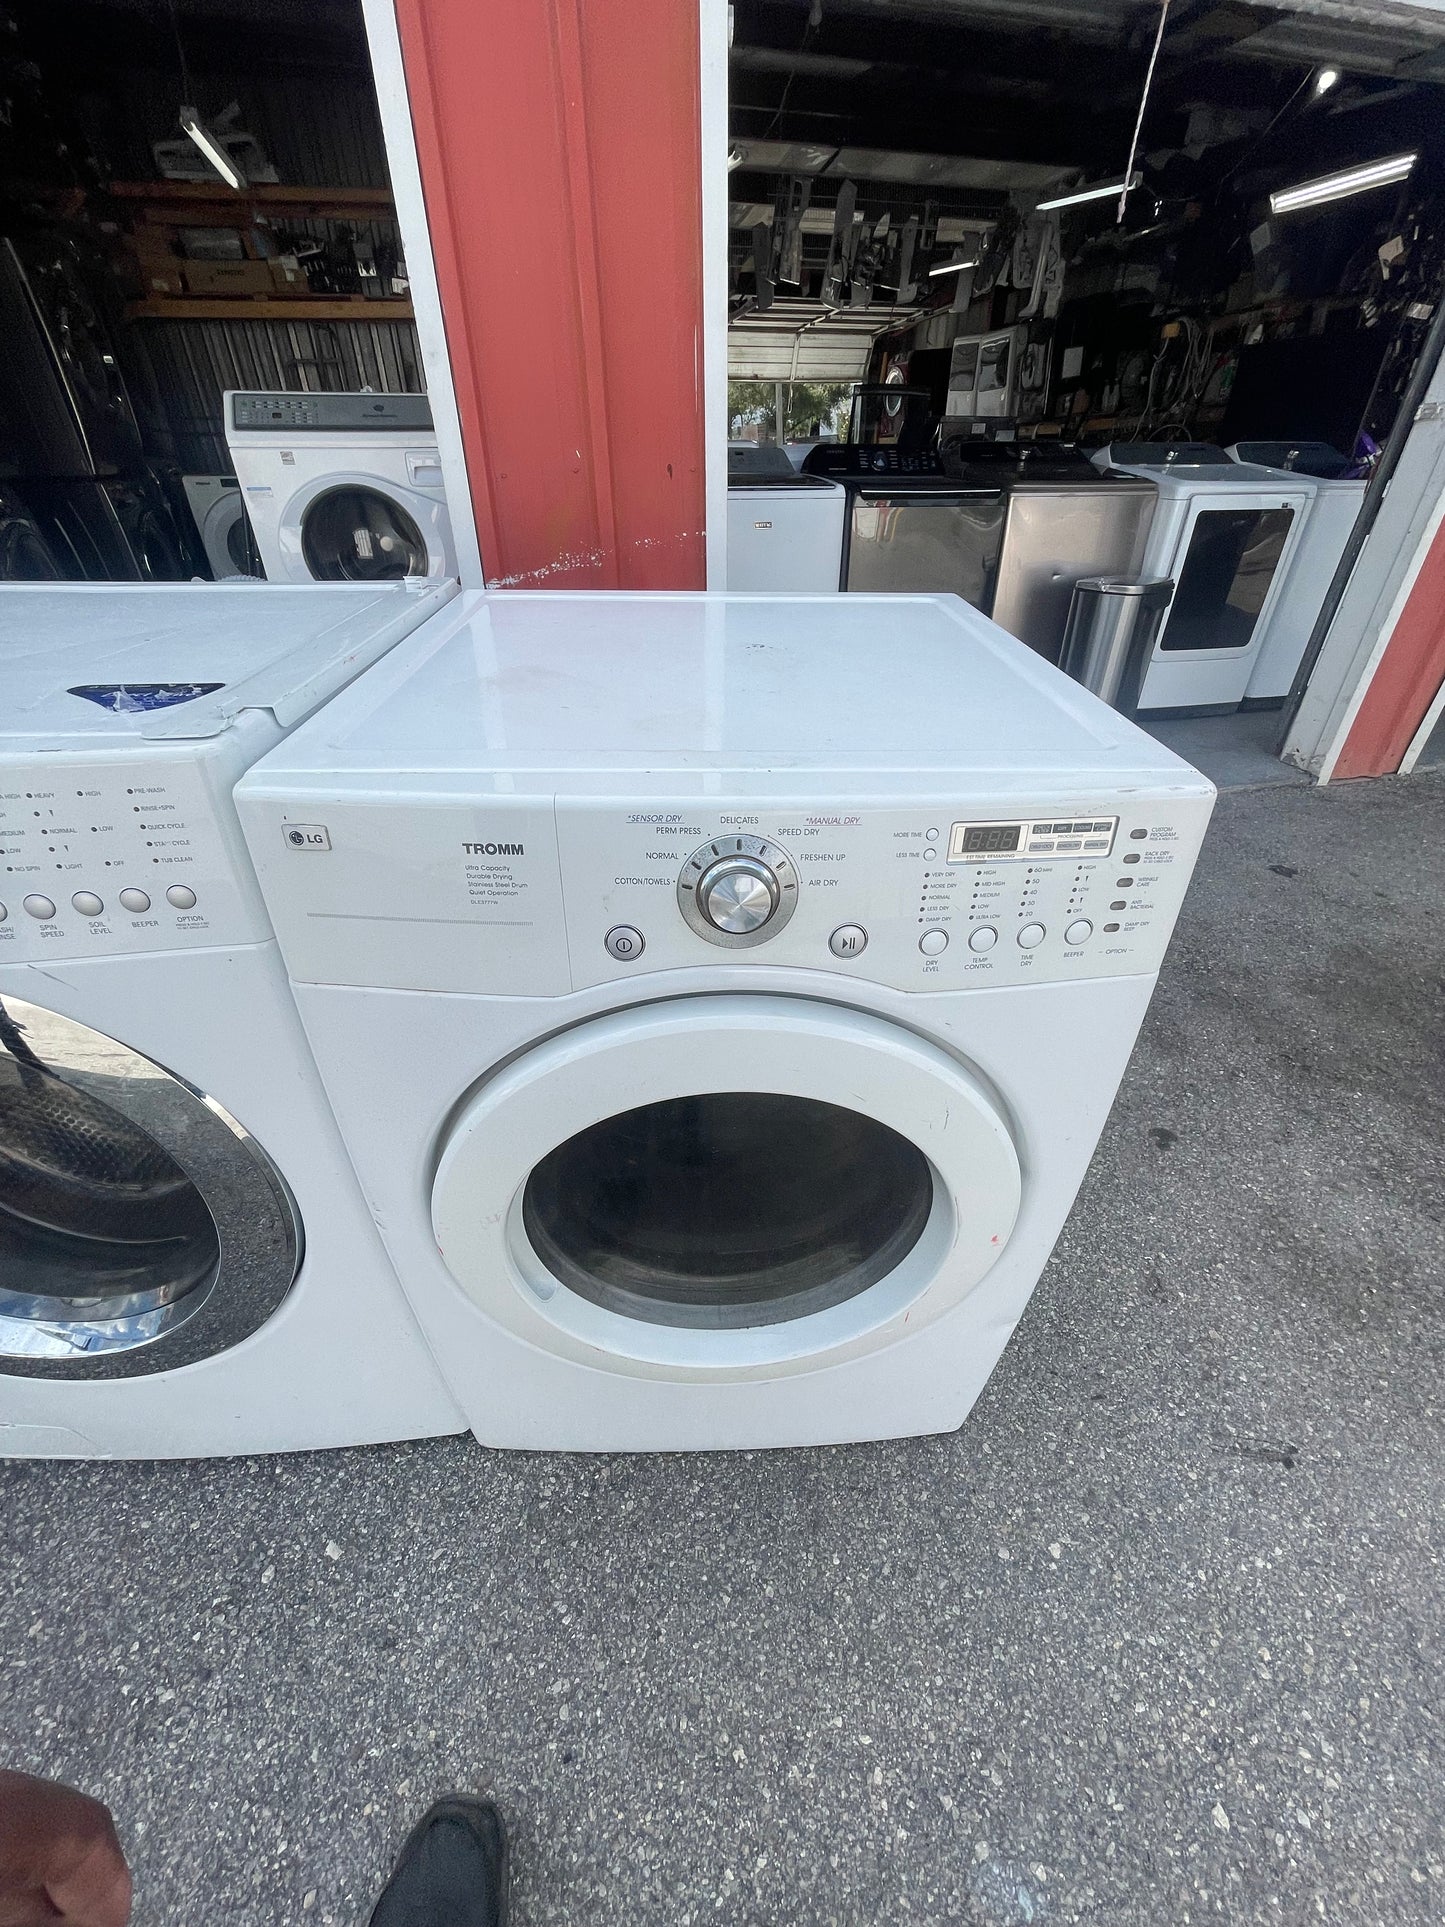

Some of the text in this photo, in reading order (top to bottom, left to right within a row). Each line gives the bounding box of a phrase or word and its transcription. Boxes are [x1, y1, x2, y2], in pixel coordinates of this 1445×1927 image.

[664, 814, 682, 822] DRY
[720, 816, 759, 824] DELICATES
[656, 827, 701, 835] PERM PRESS
[777, 828, 820, 836] SPEED DRY
[306, 834, 323, 844] LG
[462, 843, 524, 856] TROMM
[645, 852, 679, 860] NORMAL
[492, 873, 513, 881] Drying
[614, 877, 671, 886] COTTON/TOWELS
[808, 879, 839, 887] AIR DRY
[177, 915, 204, 923] OPTION
[131, 920, 159, 928] BEEPER
[41, 930, 65, 938] SPEED
